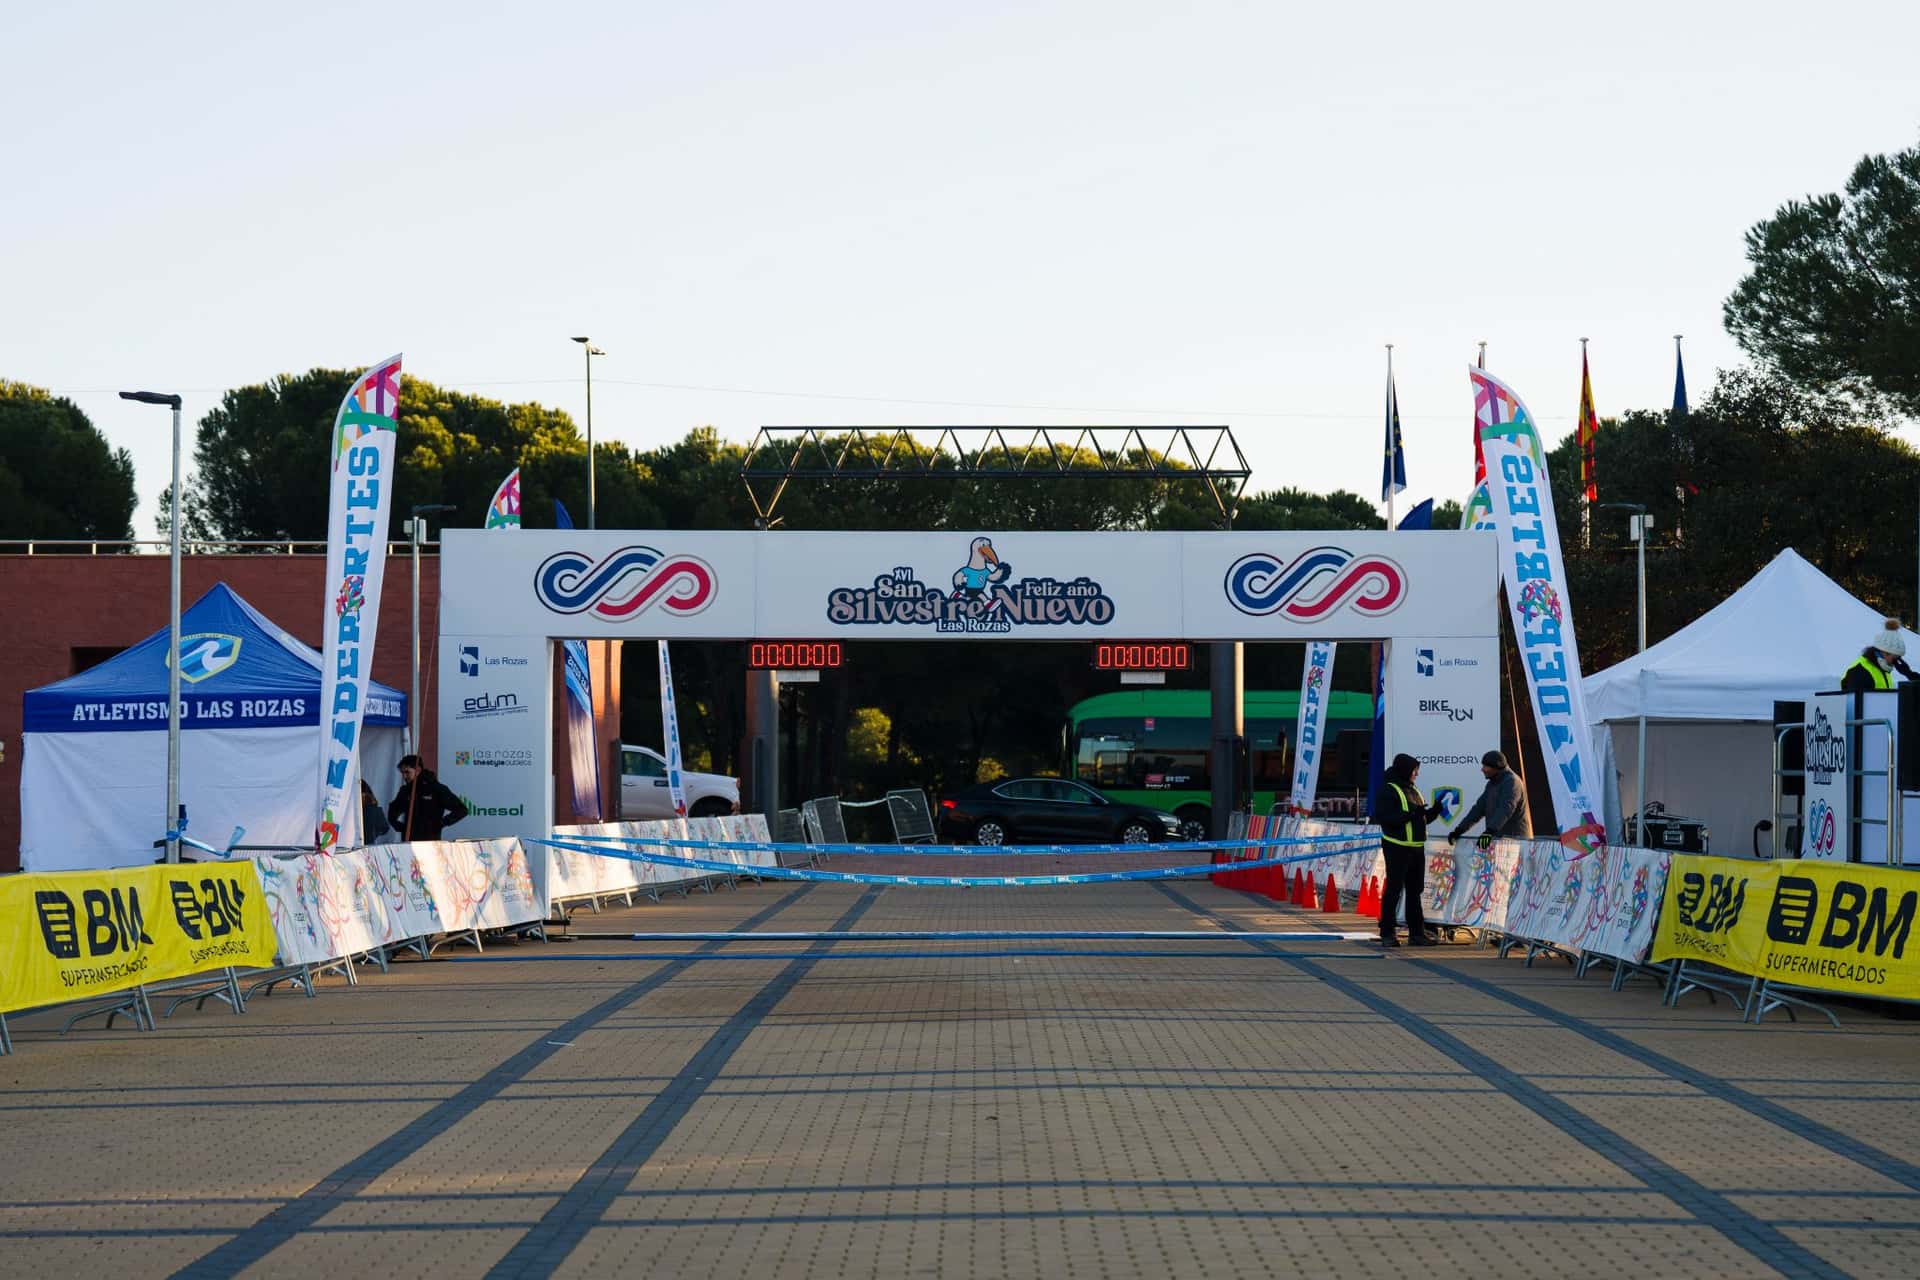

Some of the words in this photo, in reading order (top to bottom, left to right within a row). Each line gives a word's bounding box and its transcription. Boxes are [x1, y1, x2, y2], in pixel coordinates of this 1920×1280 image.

[894, 568, 912, 581] XVI
[879, 577, 923, 598] San
[1025, 581, 1061, 596] Feliz
[1067, 580, 1098, 596] año
[830, 590, 985, 621] Silvestre
[996, 587, 1111, 621] Nuevo
[938, 619, 963, 631] Las
[968, 619, 1009, 631] Rozas
[485, 657, 500, 665] Las
[502, 656, 528, 665] Rozas
[752, 644, 840, 666] 00:00:00
[1099, 646, 1188, 667] 00:00:00
[196, 700, 234, 719] LAS
[241, 699, 305, 718] ROZAS
[1419, 700, 1448, 711] BIKE
[1448, 709, 1473, 721] RUN
[495, 750, 532, 759] rozas
[83, 887, 154, 956] BM
[1819, 881, 1917, 959] BM
[1766, 953, 1887, 984] SUPERMERCADOS
